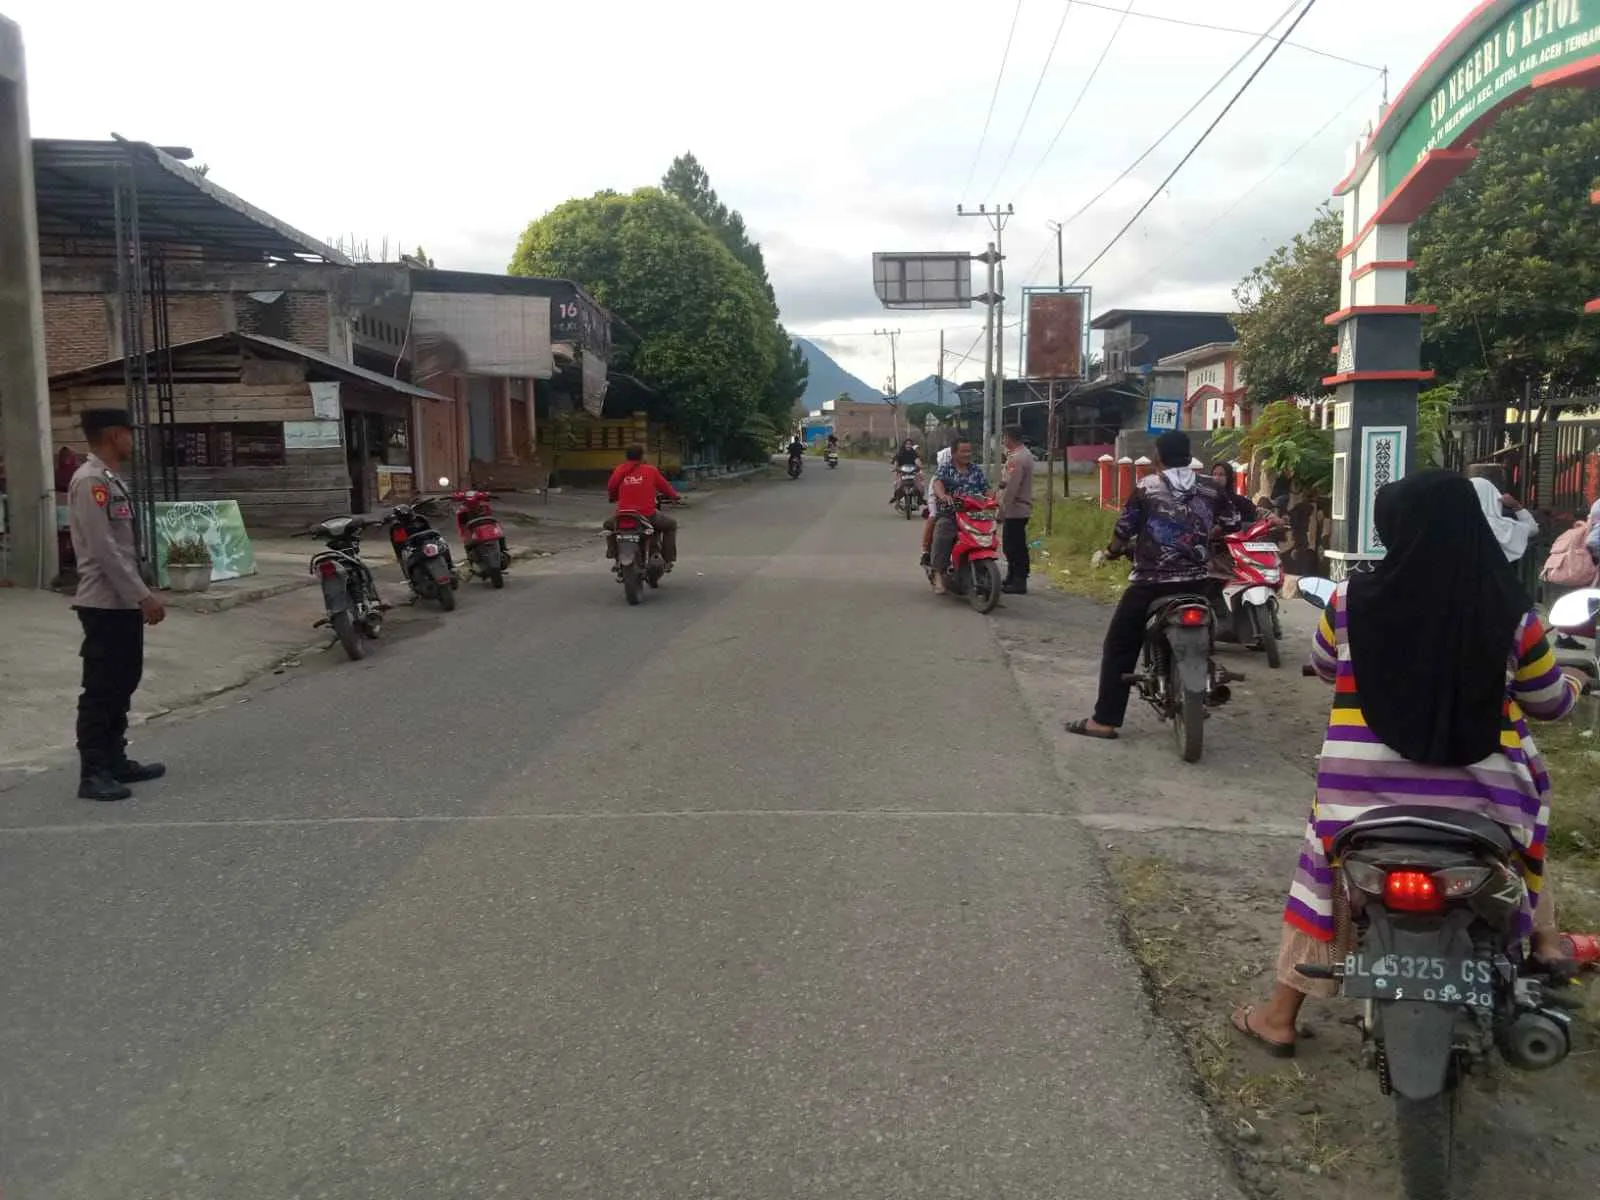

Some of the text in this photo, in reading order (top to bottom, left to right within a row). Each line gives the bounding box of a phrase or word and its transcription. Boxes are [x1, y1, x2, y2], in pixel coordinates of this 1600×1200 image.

[1430, 0, 1582, 129] SD NEGERI 6 KETOL
[1539, 41, 1562, 64] ACEH
[560, 302, 577, 318] 16
[1344, 954, 1370, 977] BL
[1385, 953, 1445, 980] 5325
